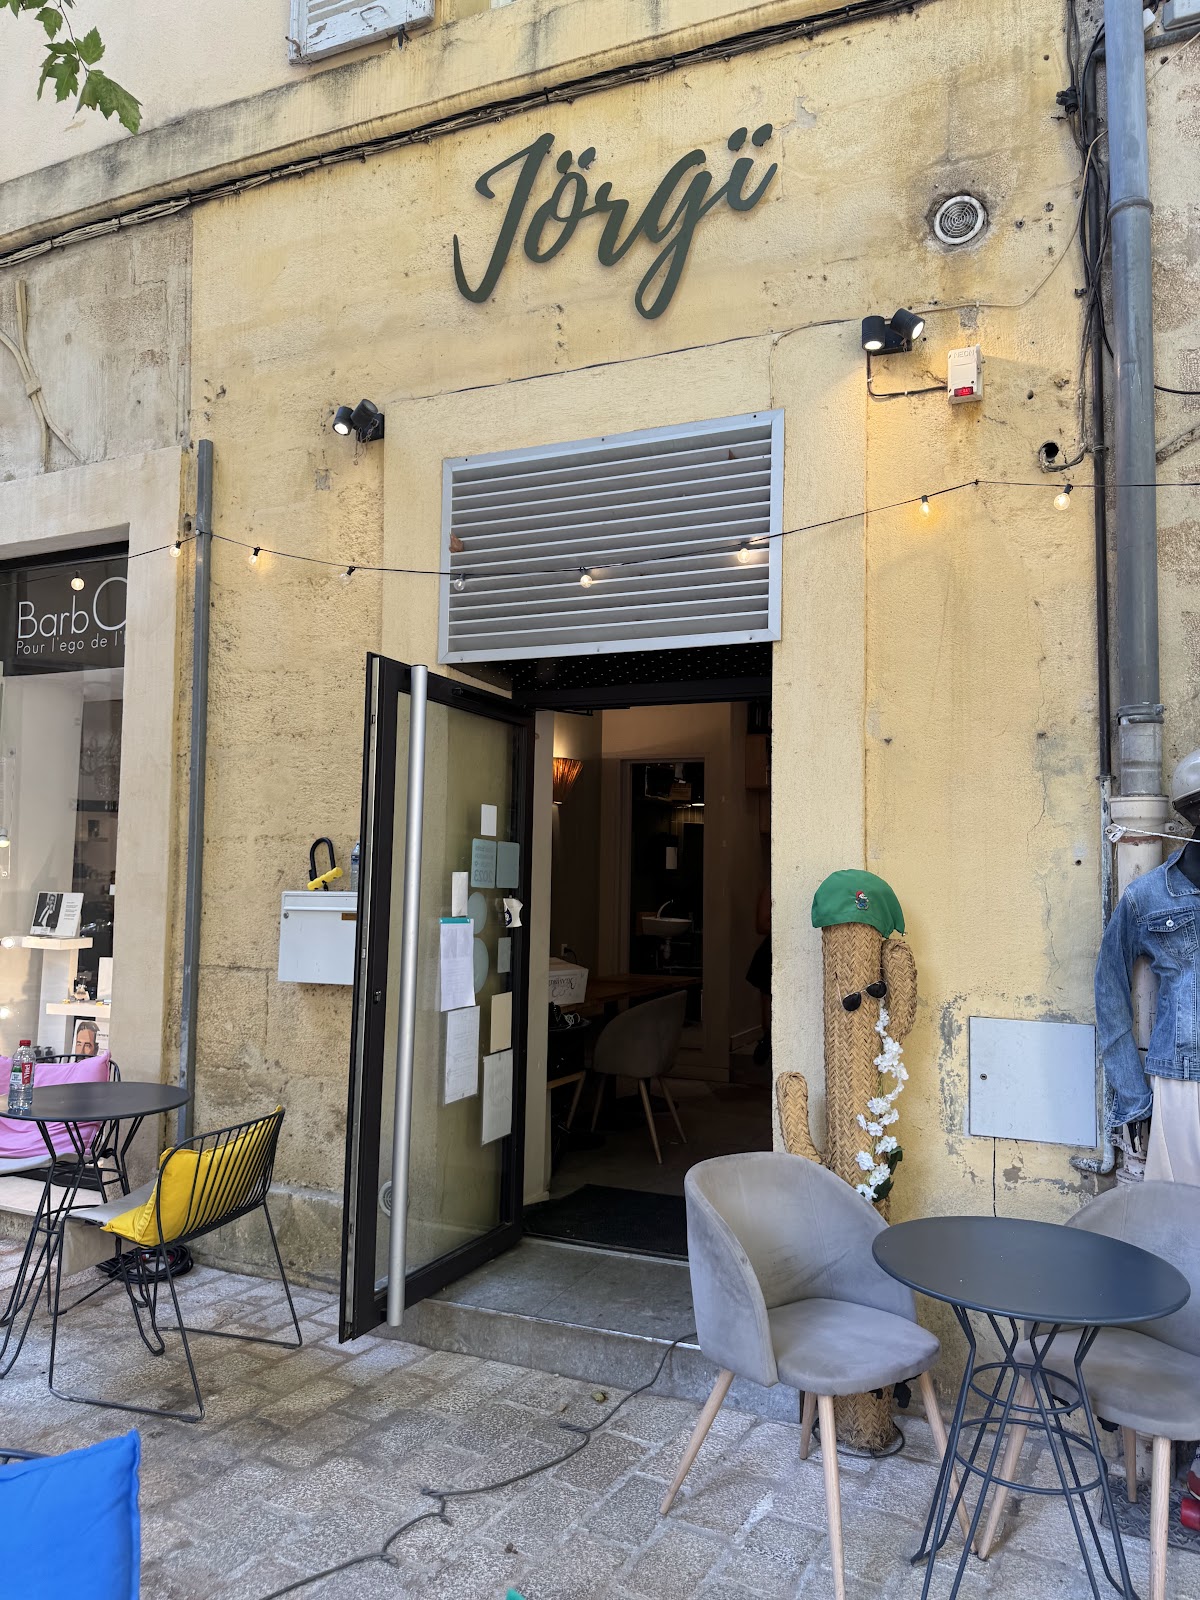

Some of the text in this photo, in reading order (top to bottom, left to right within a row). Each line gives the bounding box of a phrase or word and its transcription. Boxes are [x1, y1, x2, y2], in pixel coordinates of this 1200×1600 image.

[453, 123, 778, 319] Jörgï
[16, 640, 45, 655] Pour
[52, 637, 84, 654] l'ego
[91, 633, 108, 648] de
